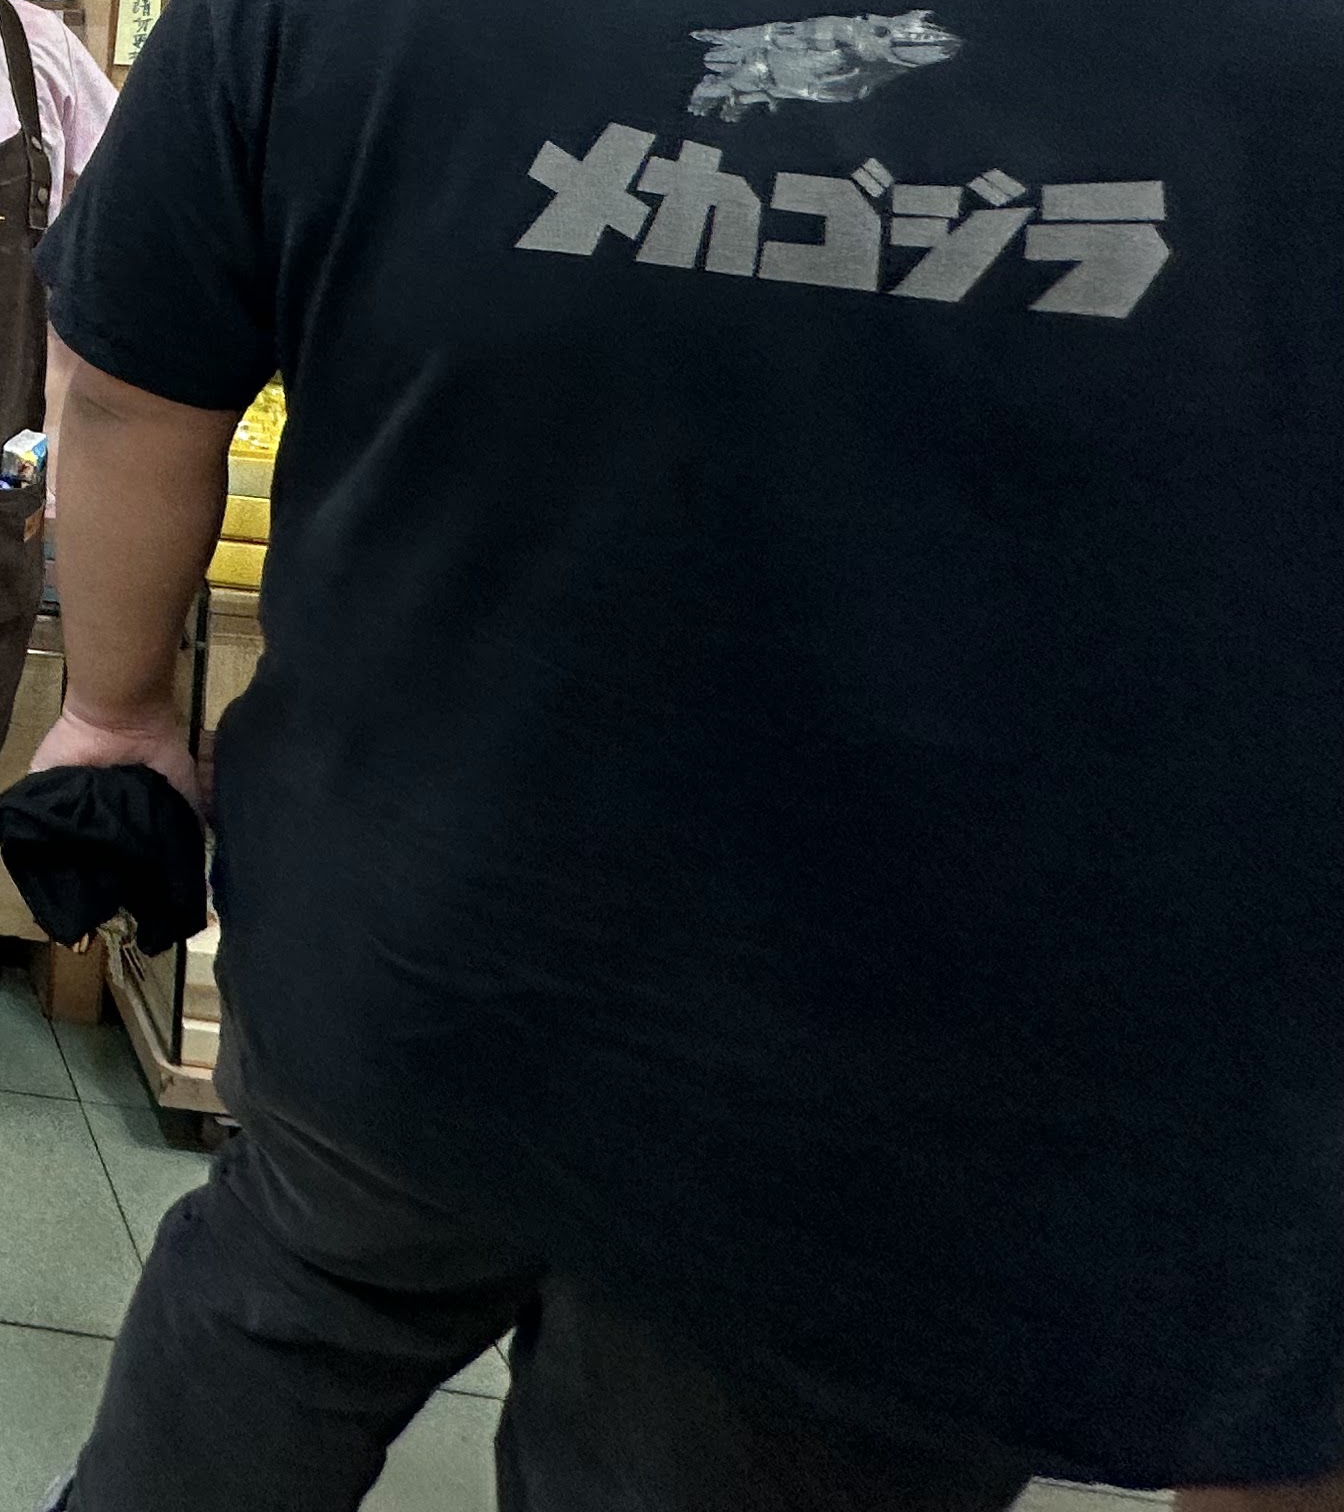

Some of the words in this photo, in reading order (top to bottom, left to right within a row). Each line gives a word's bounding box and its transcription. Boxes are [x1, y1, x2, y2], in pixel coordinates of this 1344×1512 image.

[515, 121, 1173, 319] メカゴジラ
